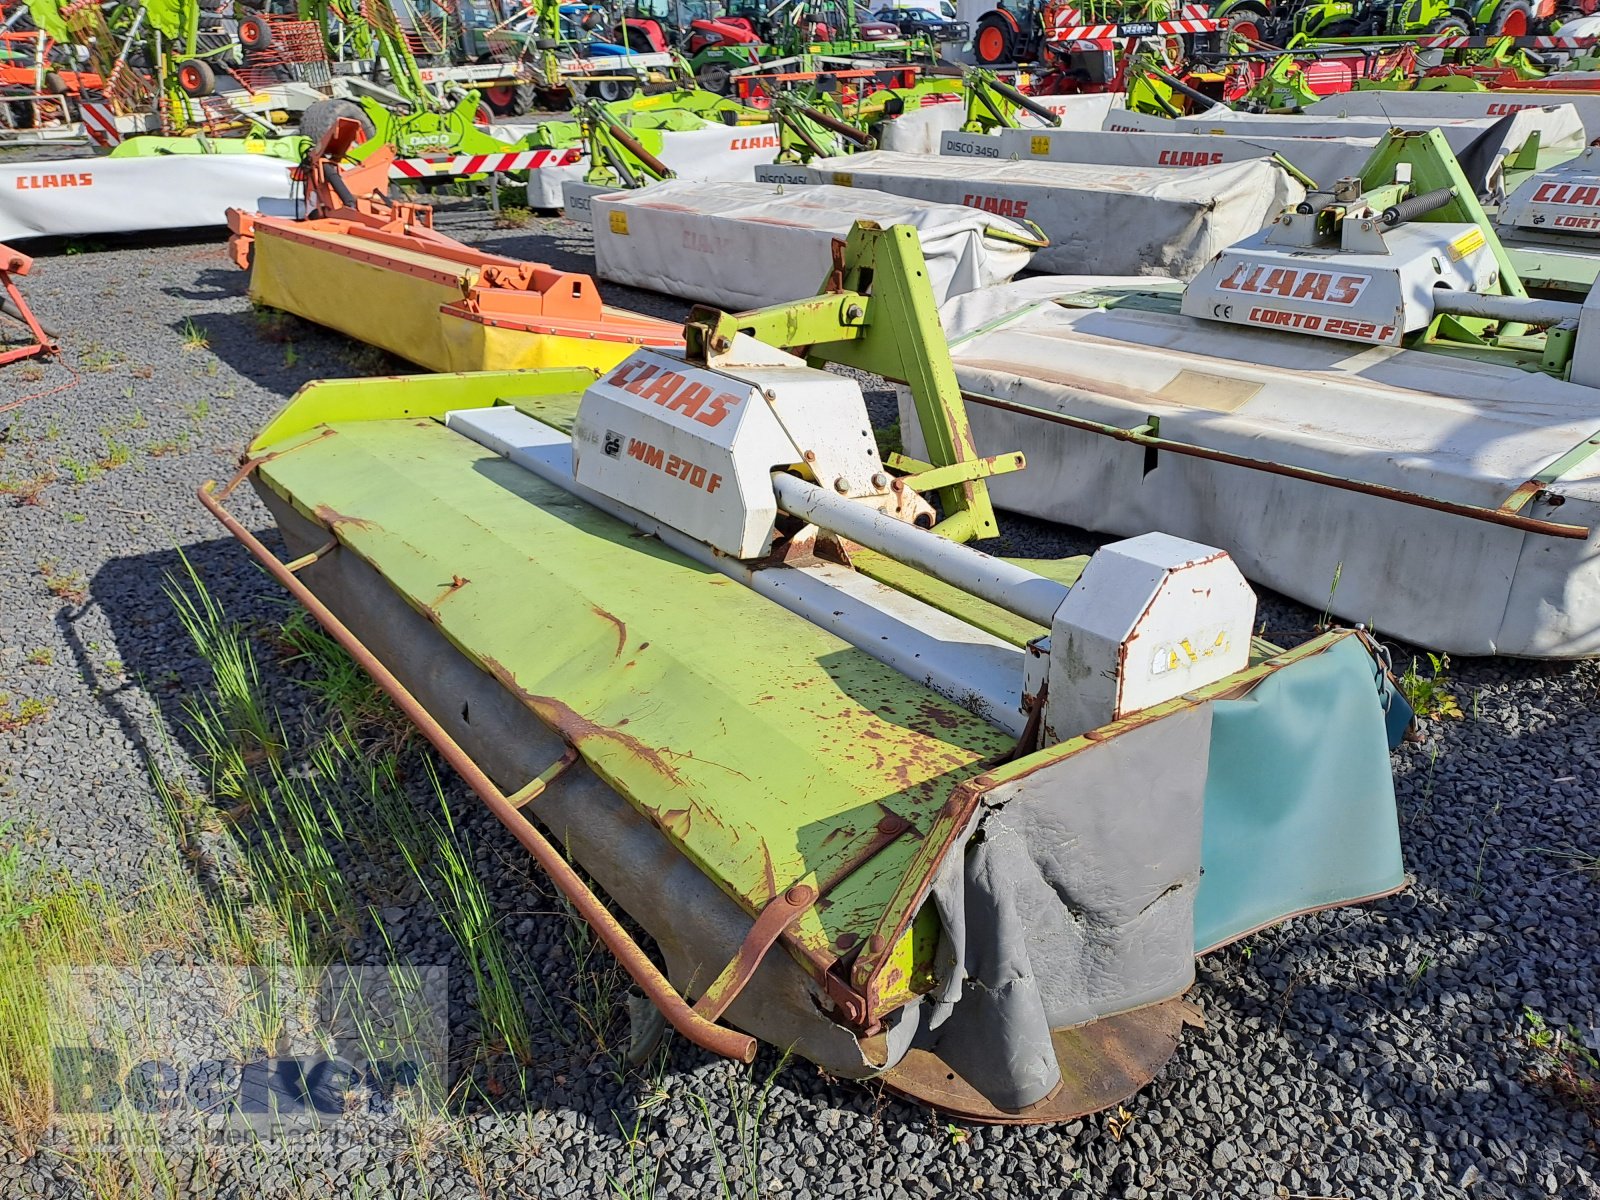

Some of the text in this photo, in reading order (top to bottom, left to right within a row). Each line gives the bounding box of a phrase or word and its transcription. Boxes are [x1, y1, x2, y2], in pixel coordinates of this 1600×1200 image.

[947, 141, 999, 158] DISCO 3450
[1158, 151, 1223, 166] CLAAS
[16, 173, 93, 189] CLAAS
[963, 195, 1028, 218] CLAAS
[1219, 263, 1364, 304] CLAAS
[1249, 308, 1395, 341] CORTO 252 F
[607, 359, 742, 427] CLAAS
[627, 438, 722, 494] WM 270 F
